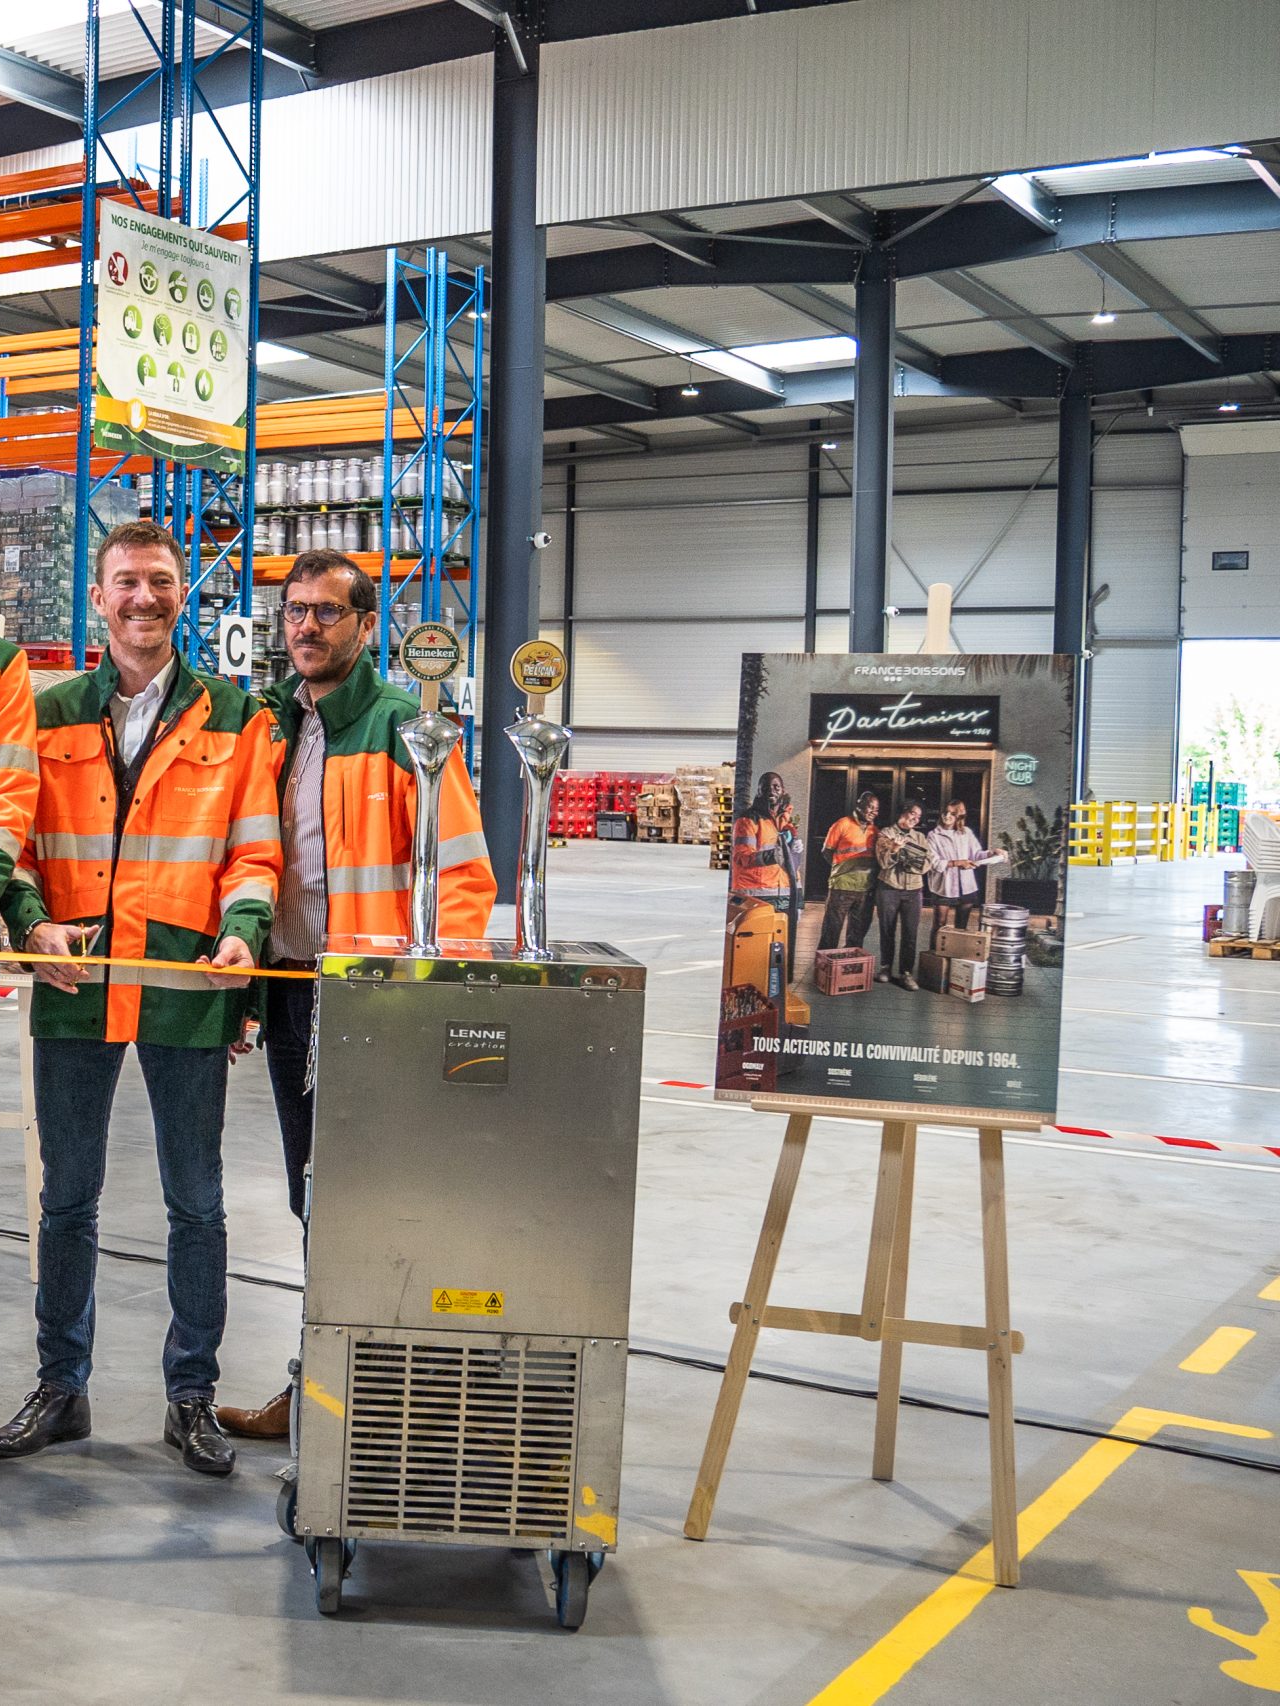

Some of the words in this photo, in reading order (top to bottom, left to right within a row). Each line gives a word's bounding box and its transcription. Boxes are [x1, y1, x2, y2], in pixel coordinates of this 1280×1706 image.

[111, 214, 128, 229] NOS
[129, 220, 188, 248] ENGAGEMENTS
[188, 239, 203, 254] QUI
[204, 245, 238, 265] SAUVENT
[141, 240, 149, 251] Je
[149, 244, 180, 261] m'engage
[180, 254, 205, 269] toujours
[226, 623, 247, 668] C
[407, 648, 456, 658] Heineken
[461, 682, 473, 710] A
[1005, 760, 1039, 772] NIGHT
[1006, 770, 1033, 785] CLUB
[449, 1029, 506, 1040] LENNE
[753, 1036, 781, 1053] TOUS
[783, 1038, 831, 1057] ACTEURS
[833, 1041, 849, 1058] DE
[850, 1043, 863, 1059] LA
[866, 1044, 940, 1063] CONVIVIALITÉ
[942, 1049, 984, 1067] DEPUIS
[987, 1051, 1021, 1069] 1964.
